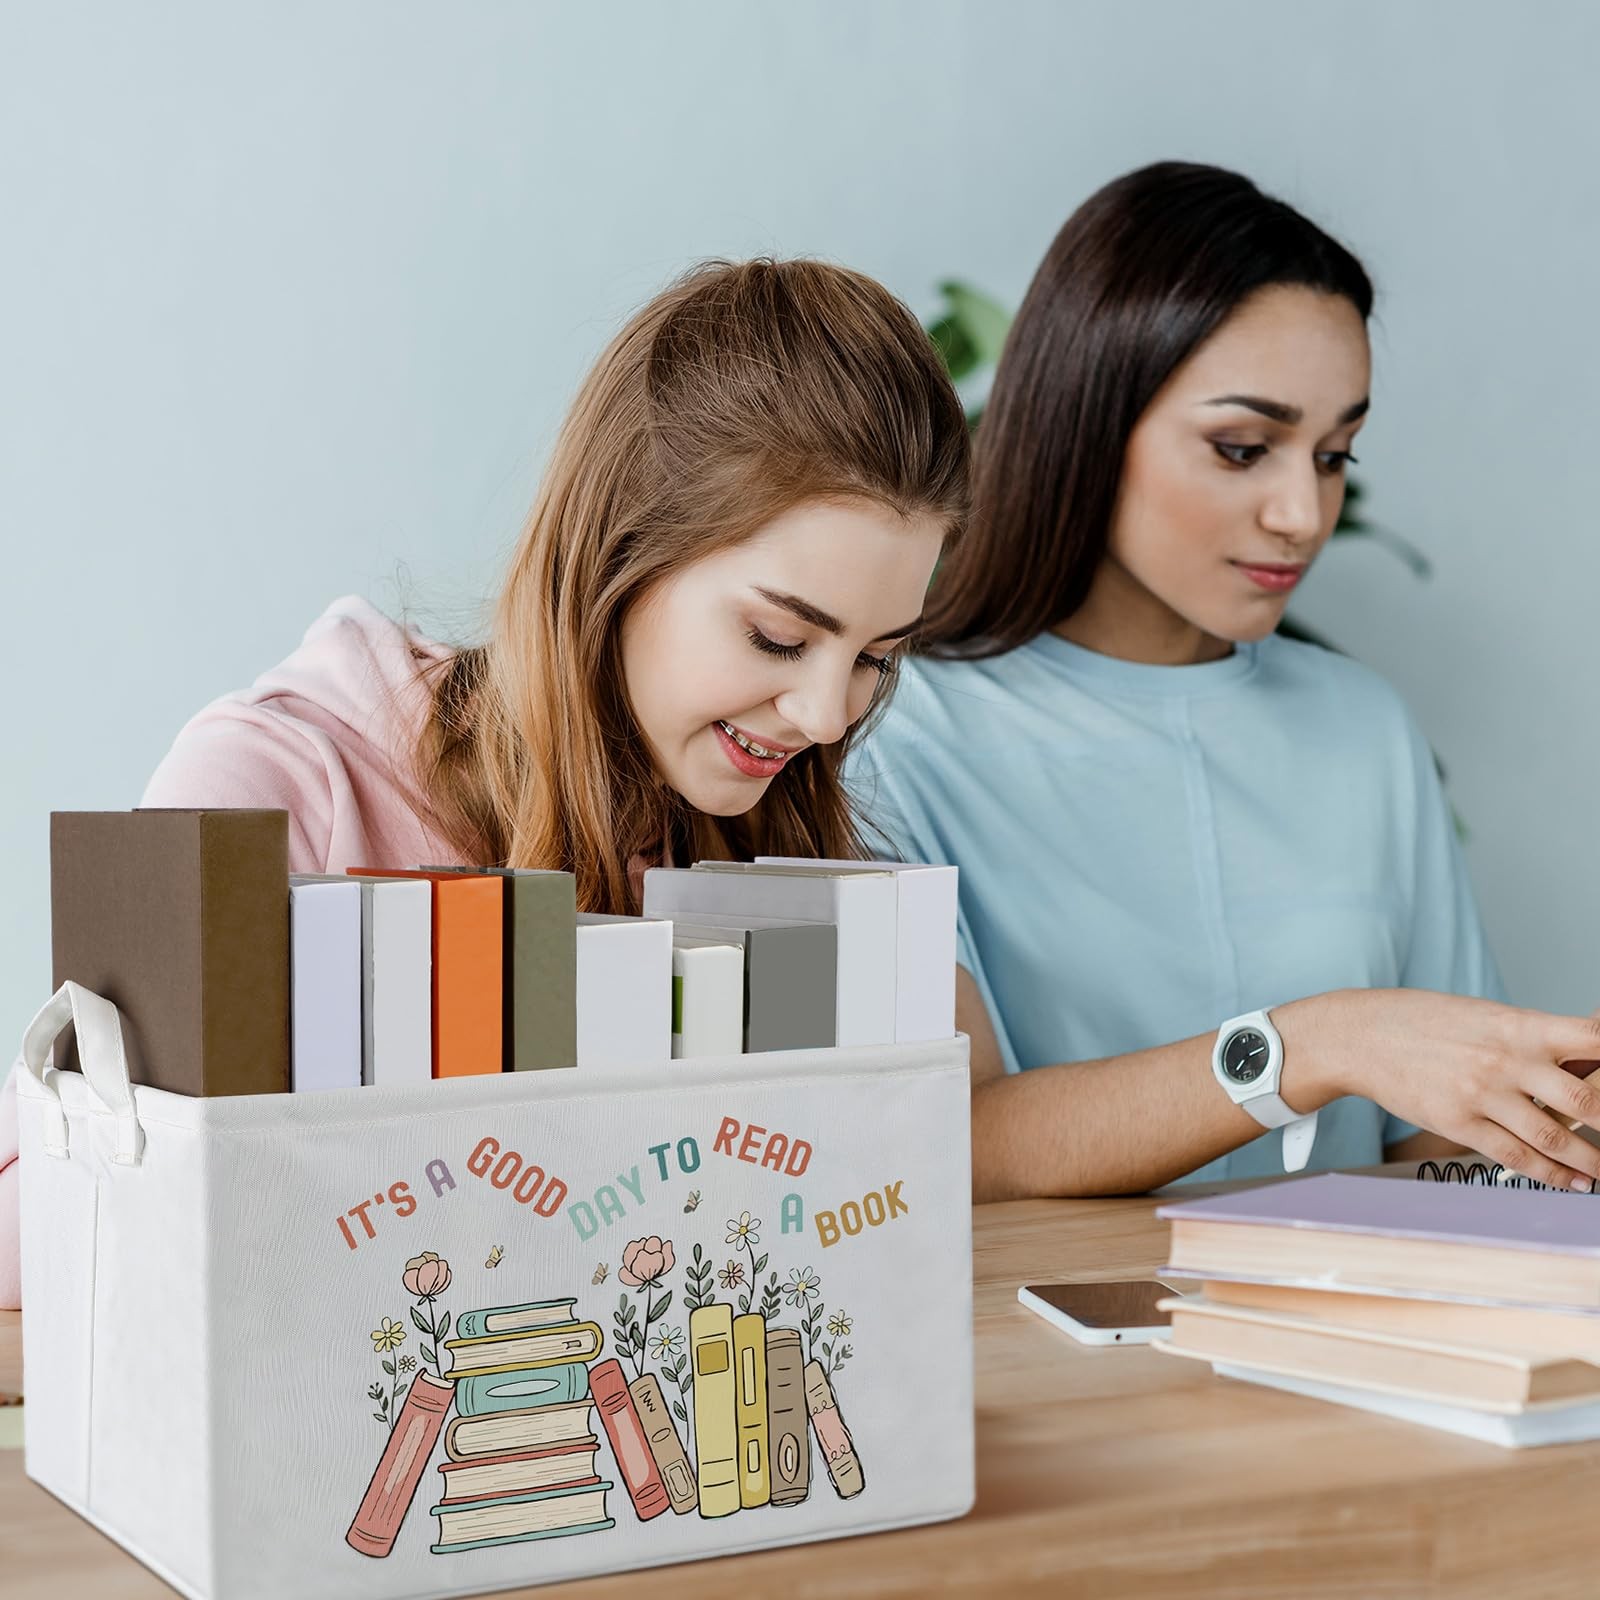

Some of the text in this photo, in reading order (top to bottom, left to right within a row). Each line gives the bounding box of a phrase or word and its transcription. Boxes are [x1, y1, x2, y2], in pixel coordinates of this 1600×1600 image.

[335, 1116, 909, 1251] IT'S A GOOD DAY TO READ A BOOK
